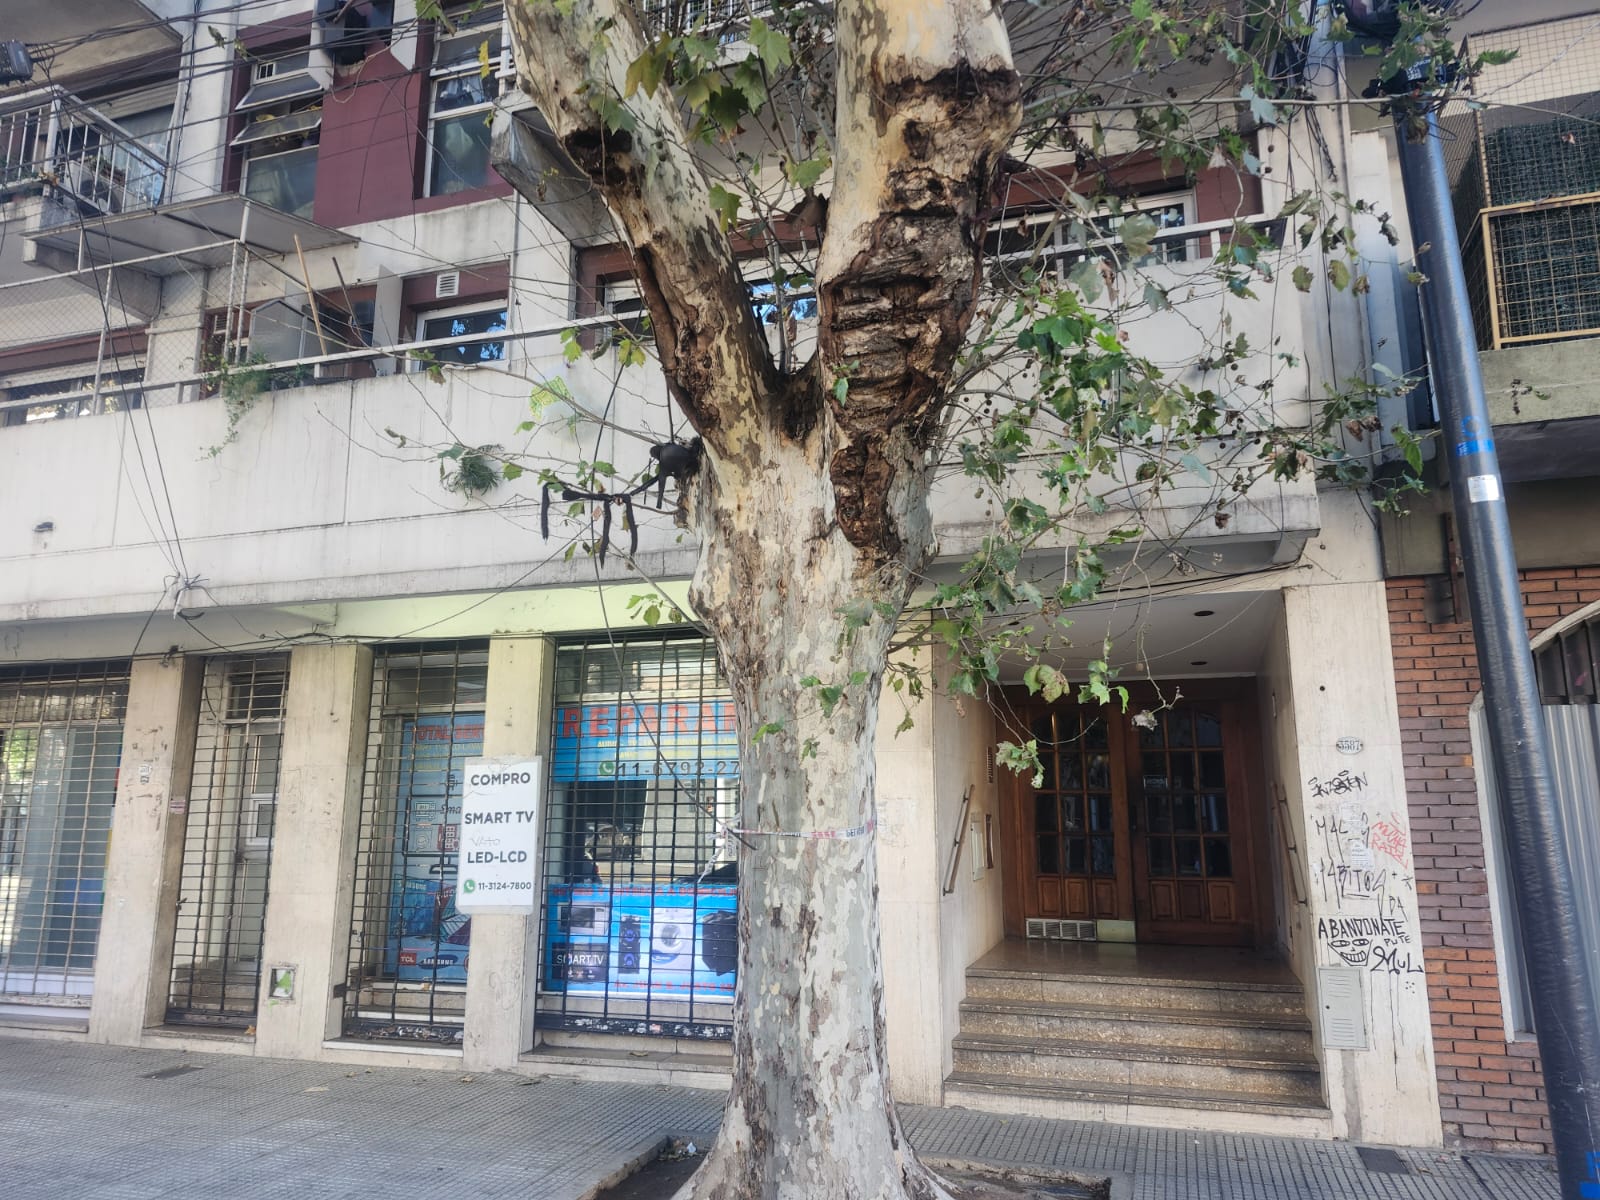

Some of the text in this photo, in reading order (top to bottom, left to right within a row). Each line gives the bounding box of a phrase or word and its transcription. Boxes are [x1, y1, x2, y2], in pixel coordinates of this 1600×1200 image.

[470, 772, 531, 786] COMPRO
[464, 811, 534, 825] SMART TV
[467, 851, 527, 864] LED-LCD
[478, 882, 532, 890] 11-3124-7800
[592, 954, 604, 965] TV
